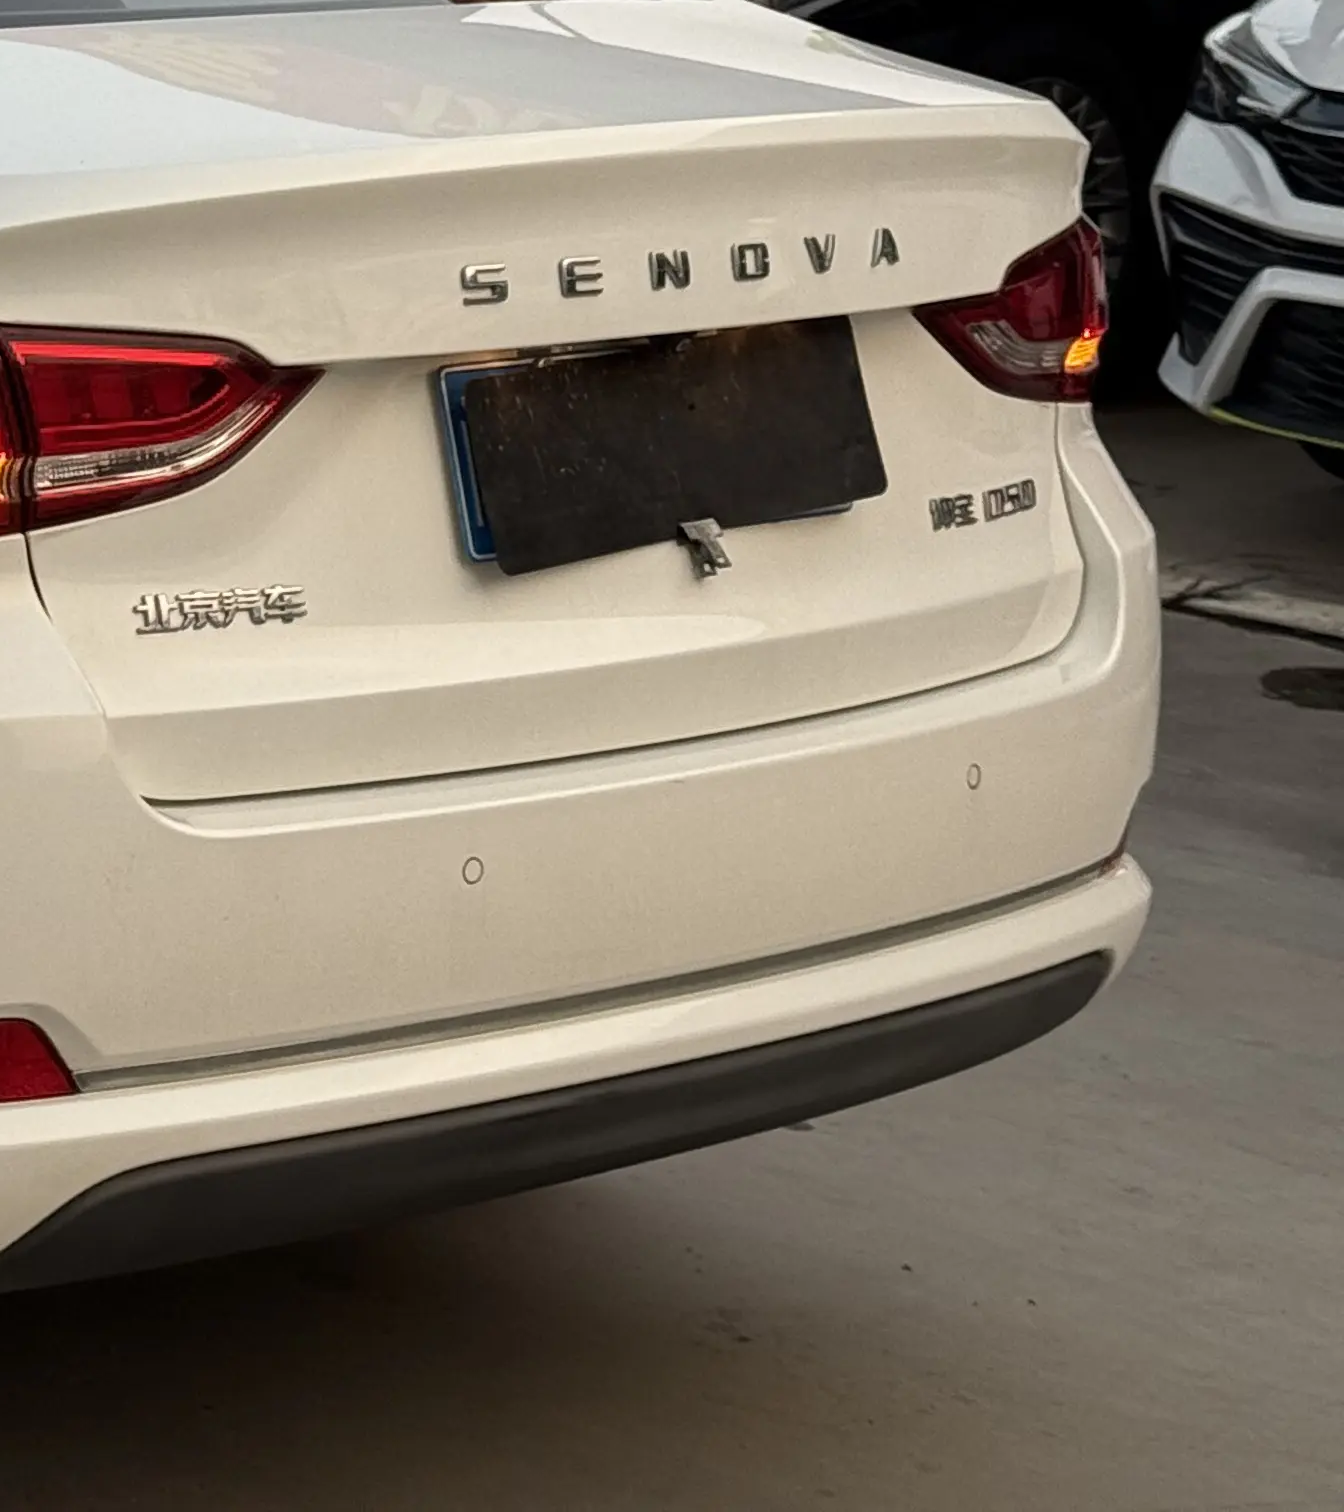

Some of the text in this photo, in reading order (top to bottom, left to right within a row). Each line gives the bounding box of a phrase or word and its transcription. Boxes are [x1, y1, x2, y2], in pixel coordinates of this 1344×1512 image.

[461, 228, 900, 306] SENOVA
[132, 585, 308, 635] 北京汽车
